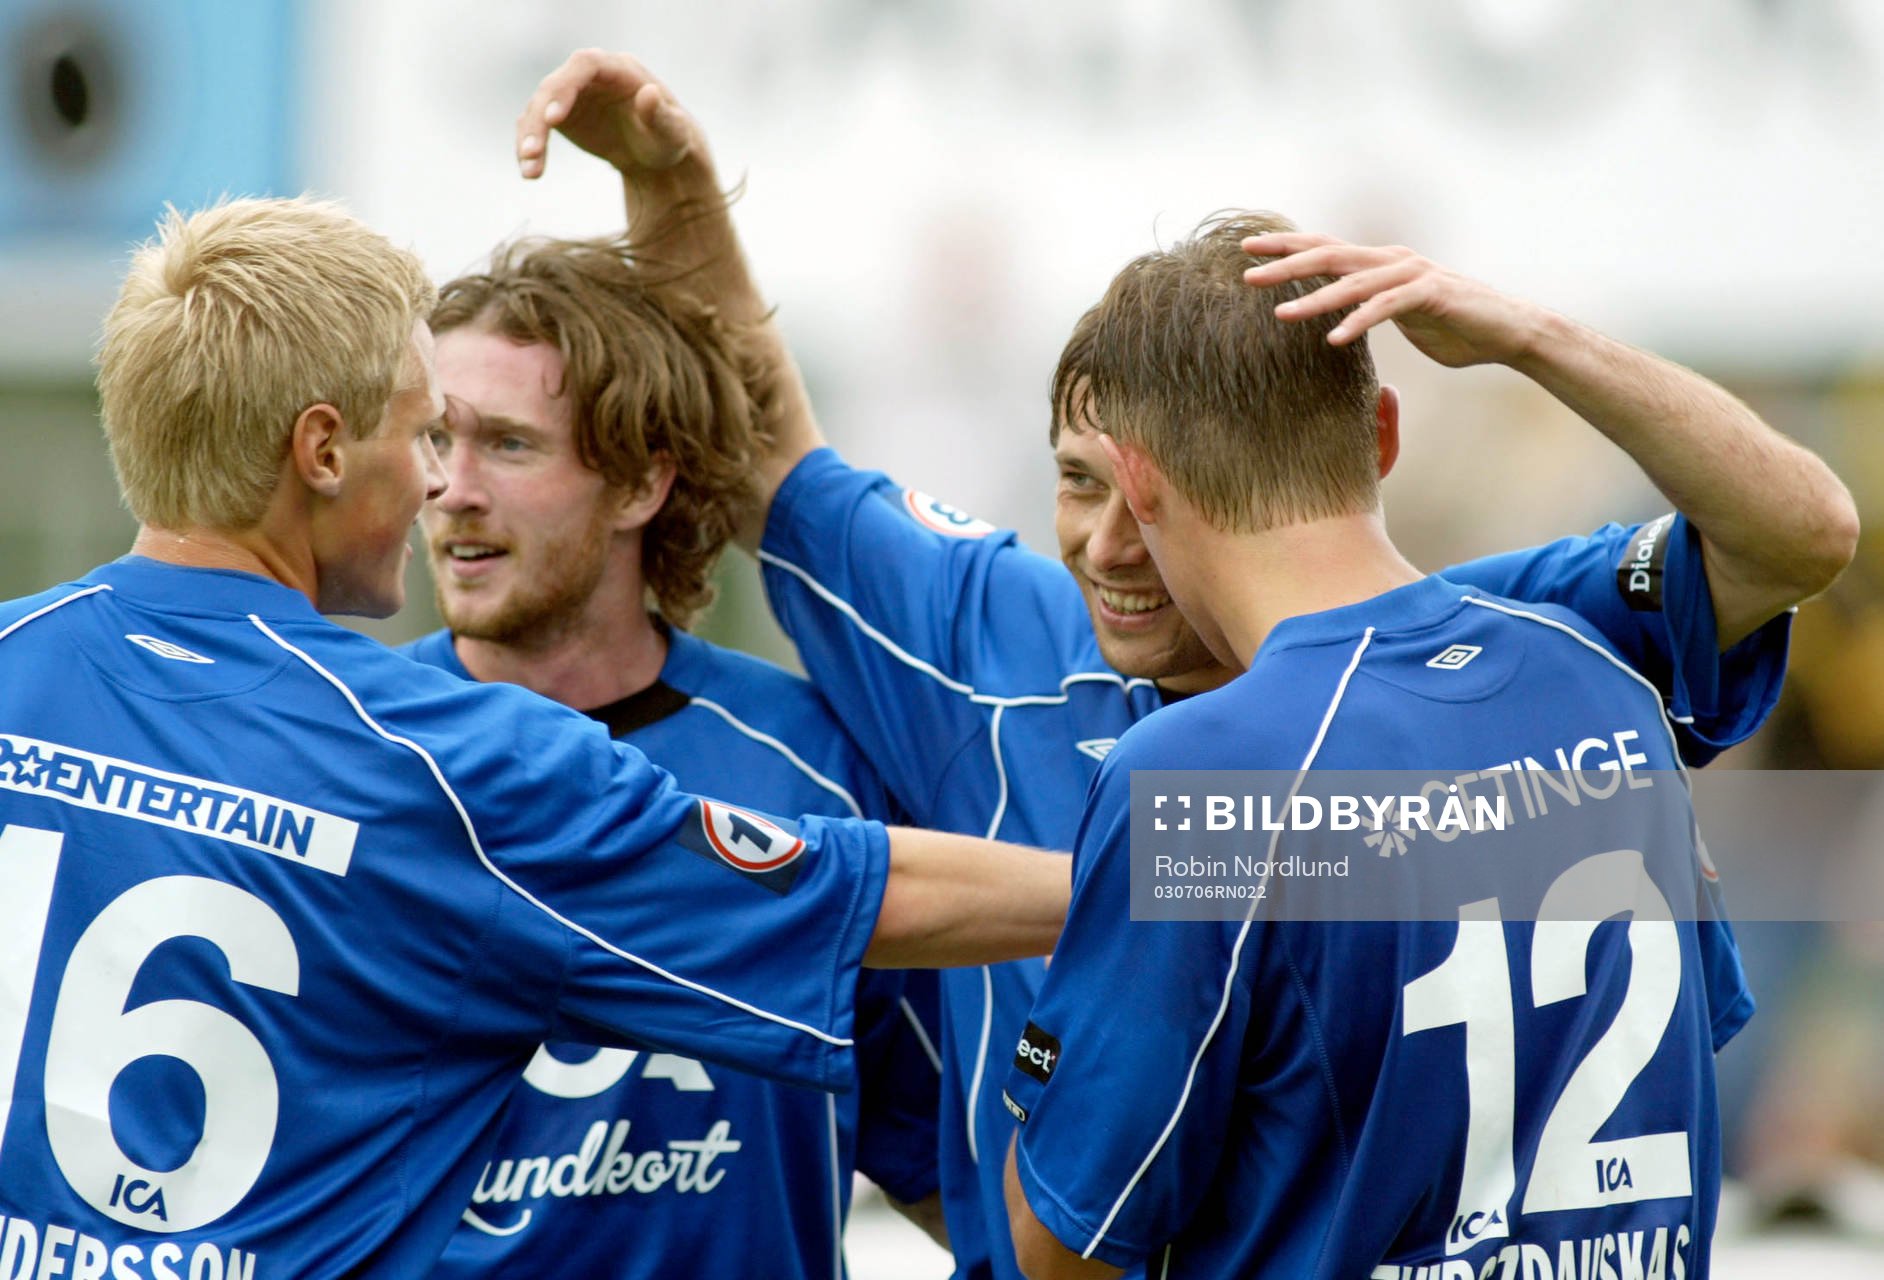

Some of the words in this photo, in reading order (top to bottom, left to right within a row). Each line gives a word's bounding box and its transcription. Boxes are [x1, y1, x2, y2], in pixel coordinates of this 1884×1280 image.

[1419, 730, 1653, 842] GETINGE
[728, 812, 773, 854] 1
[1017, 1030, 1053, 1073] ect
[1403, 850, 1692, 1255] 12
[466, 1119, 742, 1208] undkort
[1596, 1157, 1633, 1193] ICA
[108, 1173, 168, 1222] ICA
[1450, 1210, 1503, 1243] ICA
